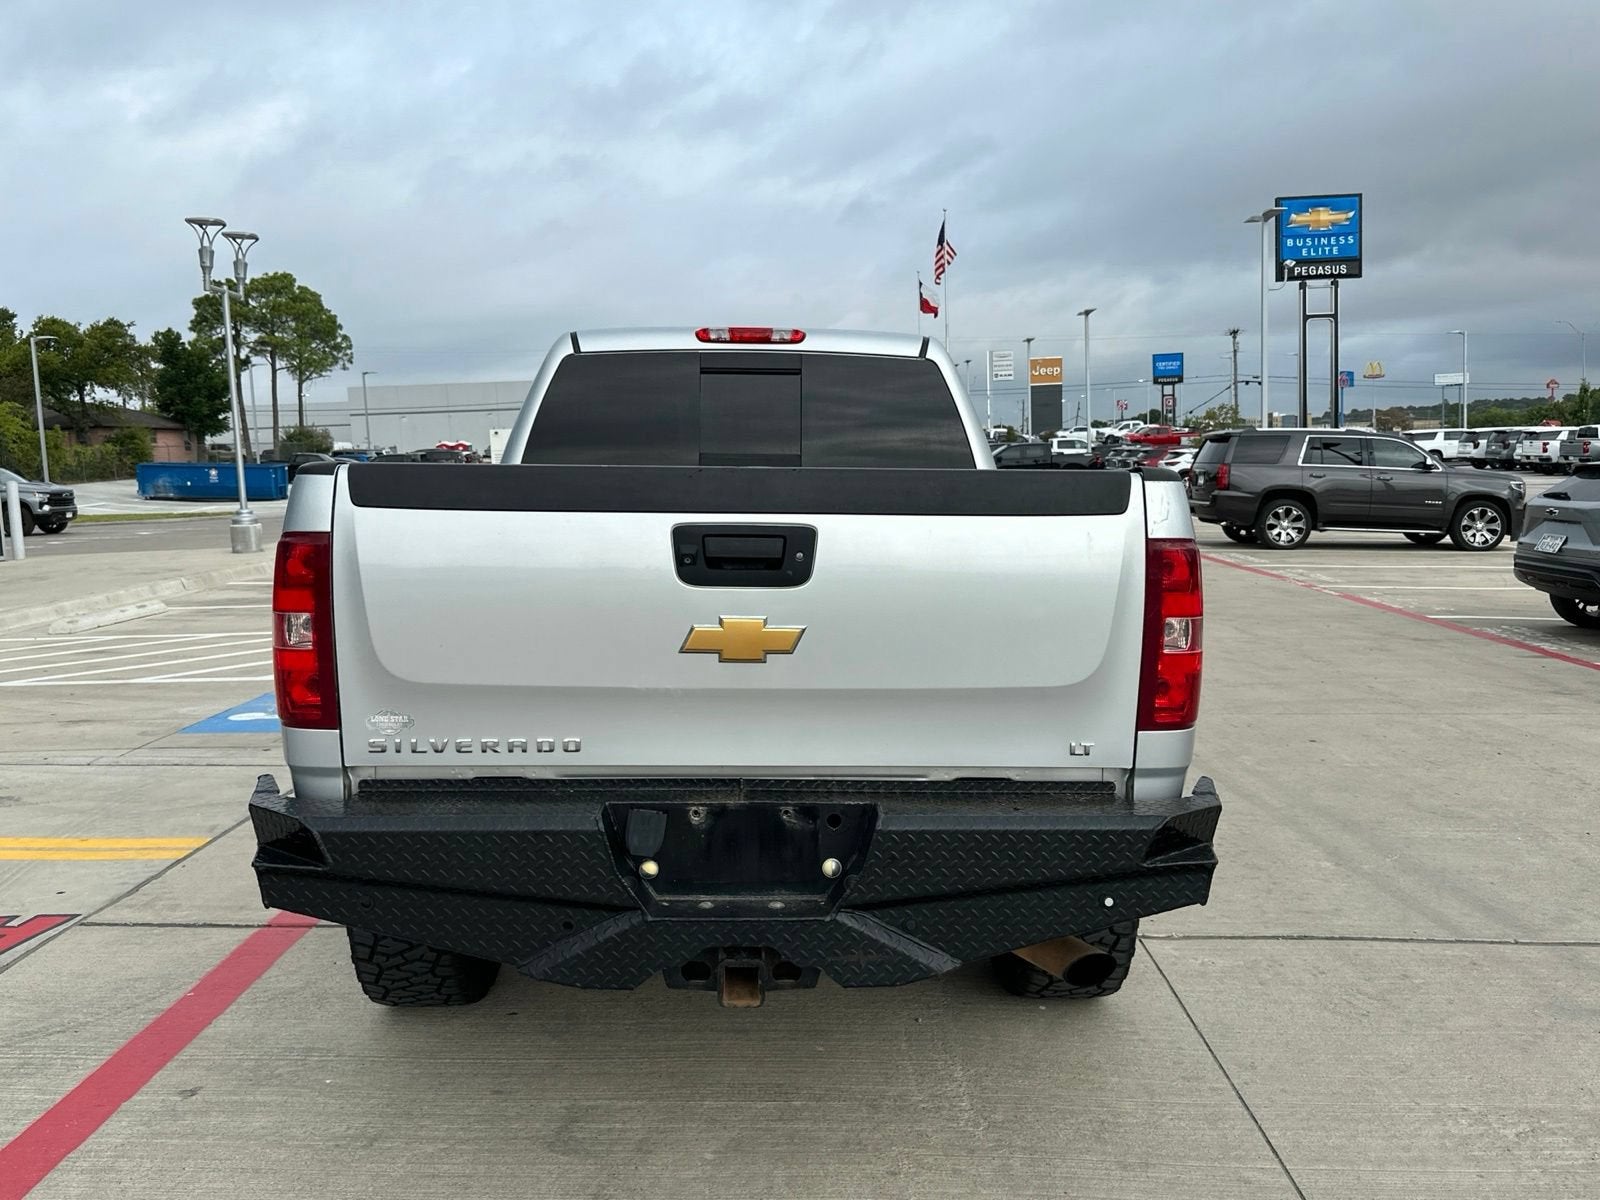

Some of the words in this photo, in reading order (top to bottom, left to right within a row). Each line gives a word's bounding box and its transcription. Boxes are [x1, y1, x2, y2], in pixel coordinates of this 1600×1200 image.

[1286, 235, 1355, 247] BUSINESS
[1301, 246, 1340, 257] ELITE
[1294, 264, 1348, 277] PEGASUS
[1031, 364, 1061, 376] Jeep
[367, 738, 583, 754] SILVERADO
[1069, 742, 1096, 756] LT
